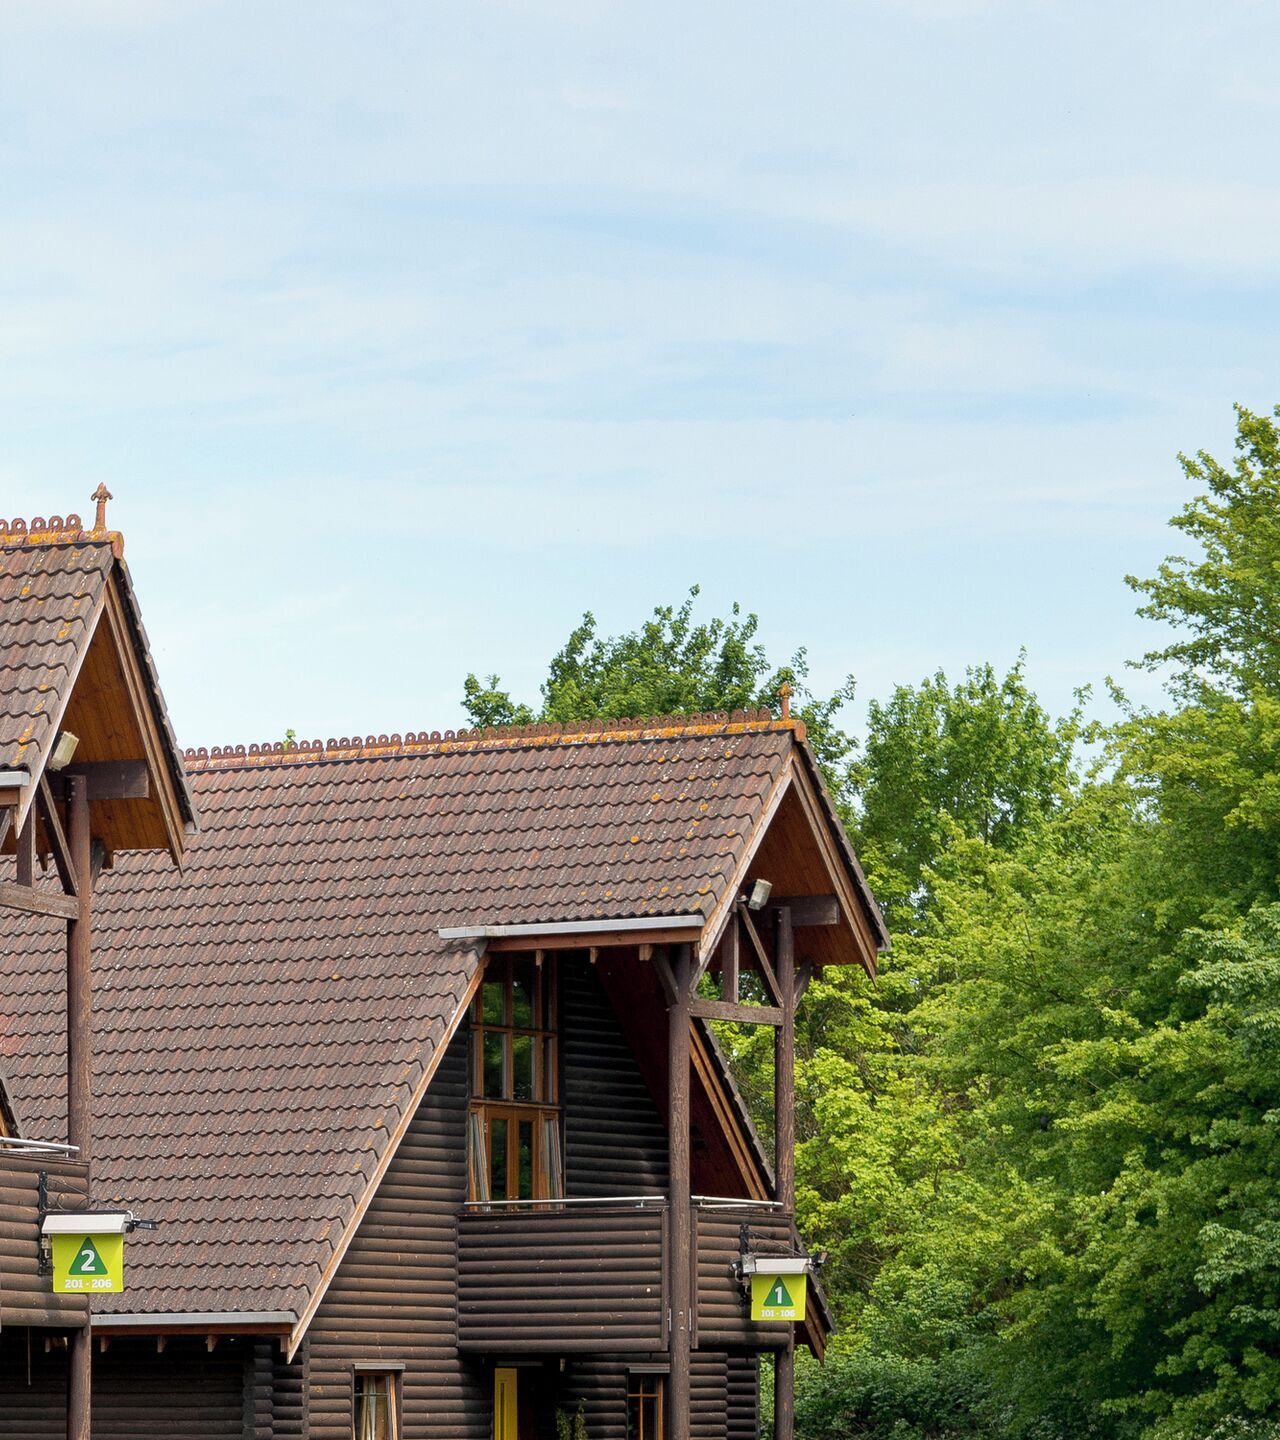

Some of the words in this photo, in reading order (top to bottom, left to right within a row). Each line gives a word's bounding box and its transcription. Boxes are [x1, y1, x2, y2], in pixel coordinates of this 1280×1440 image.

[80, 1249, 96, 1272] 2
[64, 1279, 83, 1289] 201
[91, 1279, 112, 1289] 206
[774, 1286, 783, 1305] 1
